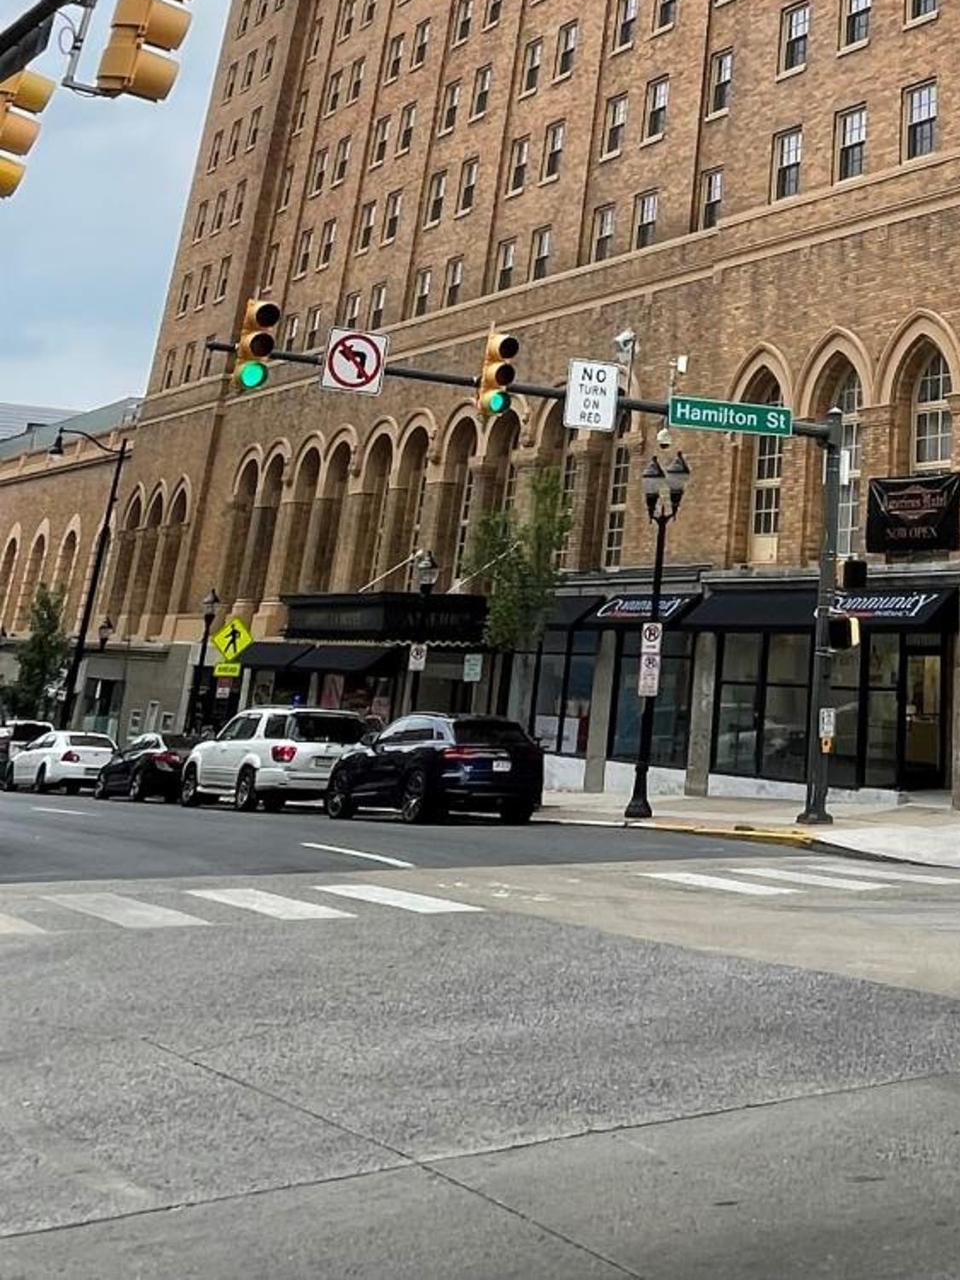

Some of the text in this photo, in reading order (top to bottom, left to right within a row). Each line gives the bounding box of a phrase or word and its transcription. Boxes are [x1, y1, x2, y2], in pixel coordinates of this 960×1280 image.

[581, 367, 607, 383] NO
[578, 383, 607, 396] TURN
[583, 398, 600, 410] ON
[579, 412, 601, 424] RED
[676, 402, 785, 429] Hamilton St
